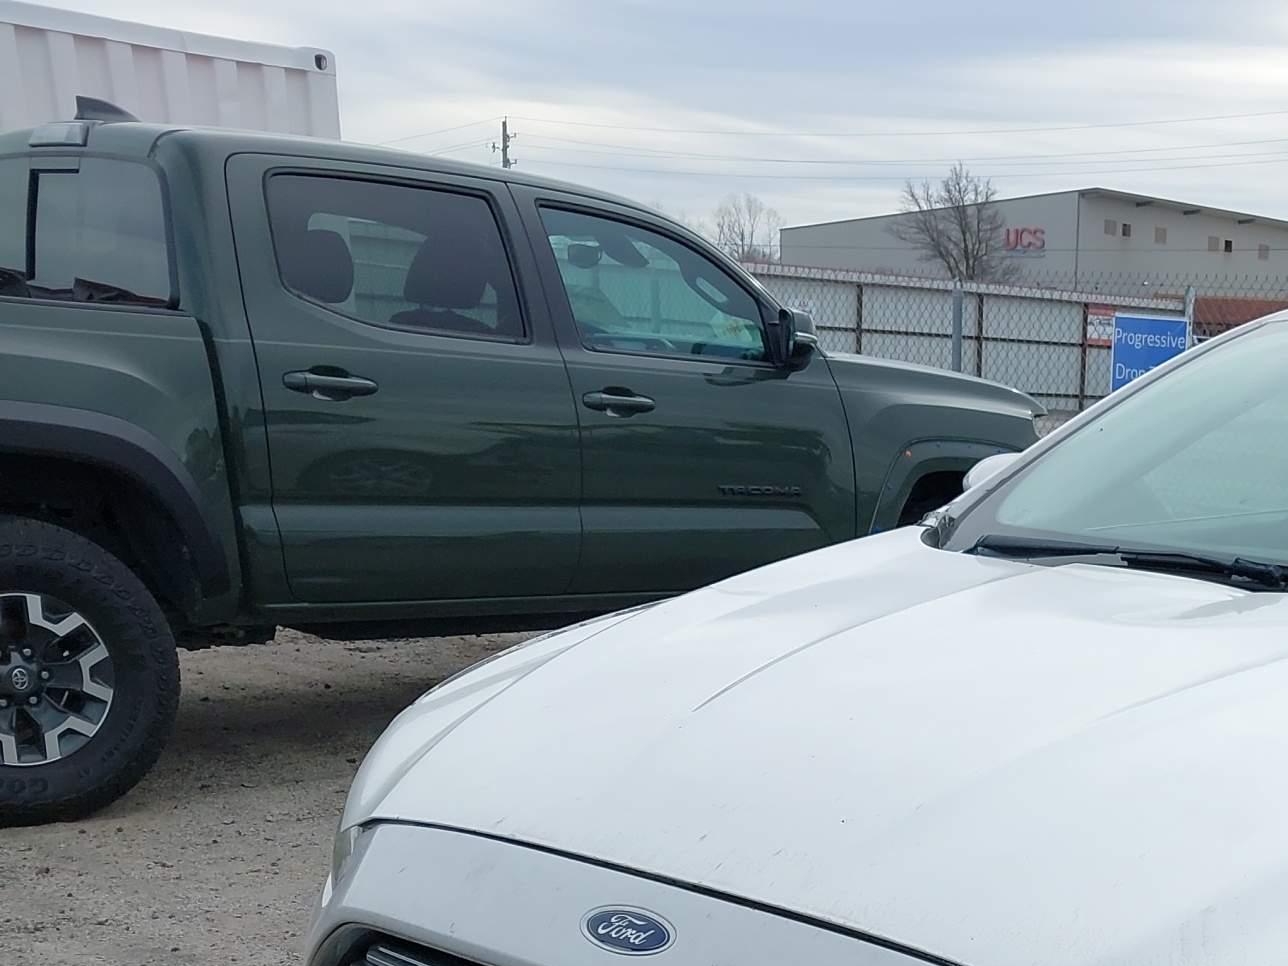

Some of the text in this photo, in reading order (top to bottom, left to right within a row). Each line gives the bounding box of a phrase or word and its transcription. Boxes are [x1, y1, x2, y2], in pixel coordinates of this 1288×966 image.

[1006, 227, 1045, 251] UCS
[1114, 328, 1185, 349] Progressive
[597, 914, 656, 945] Ford
